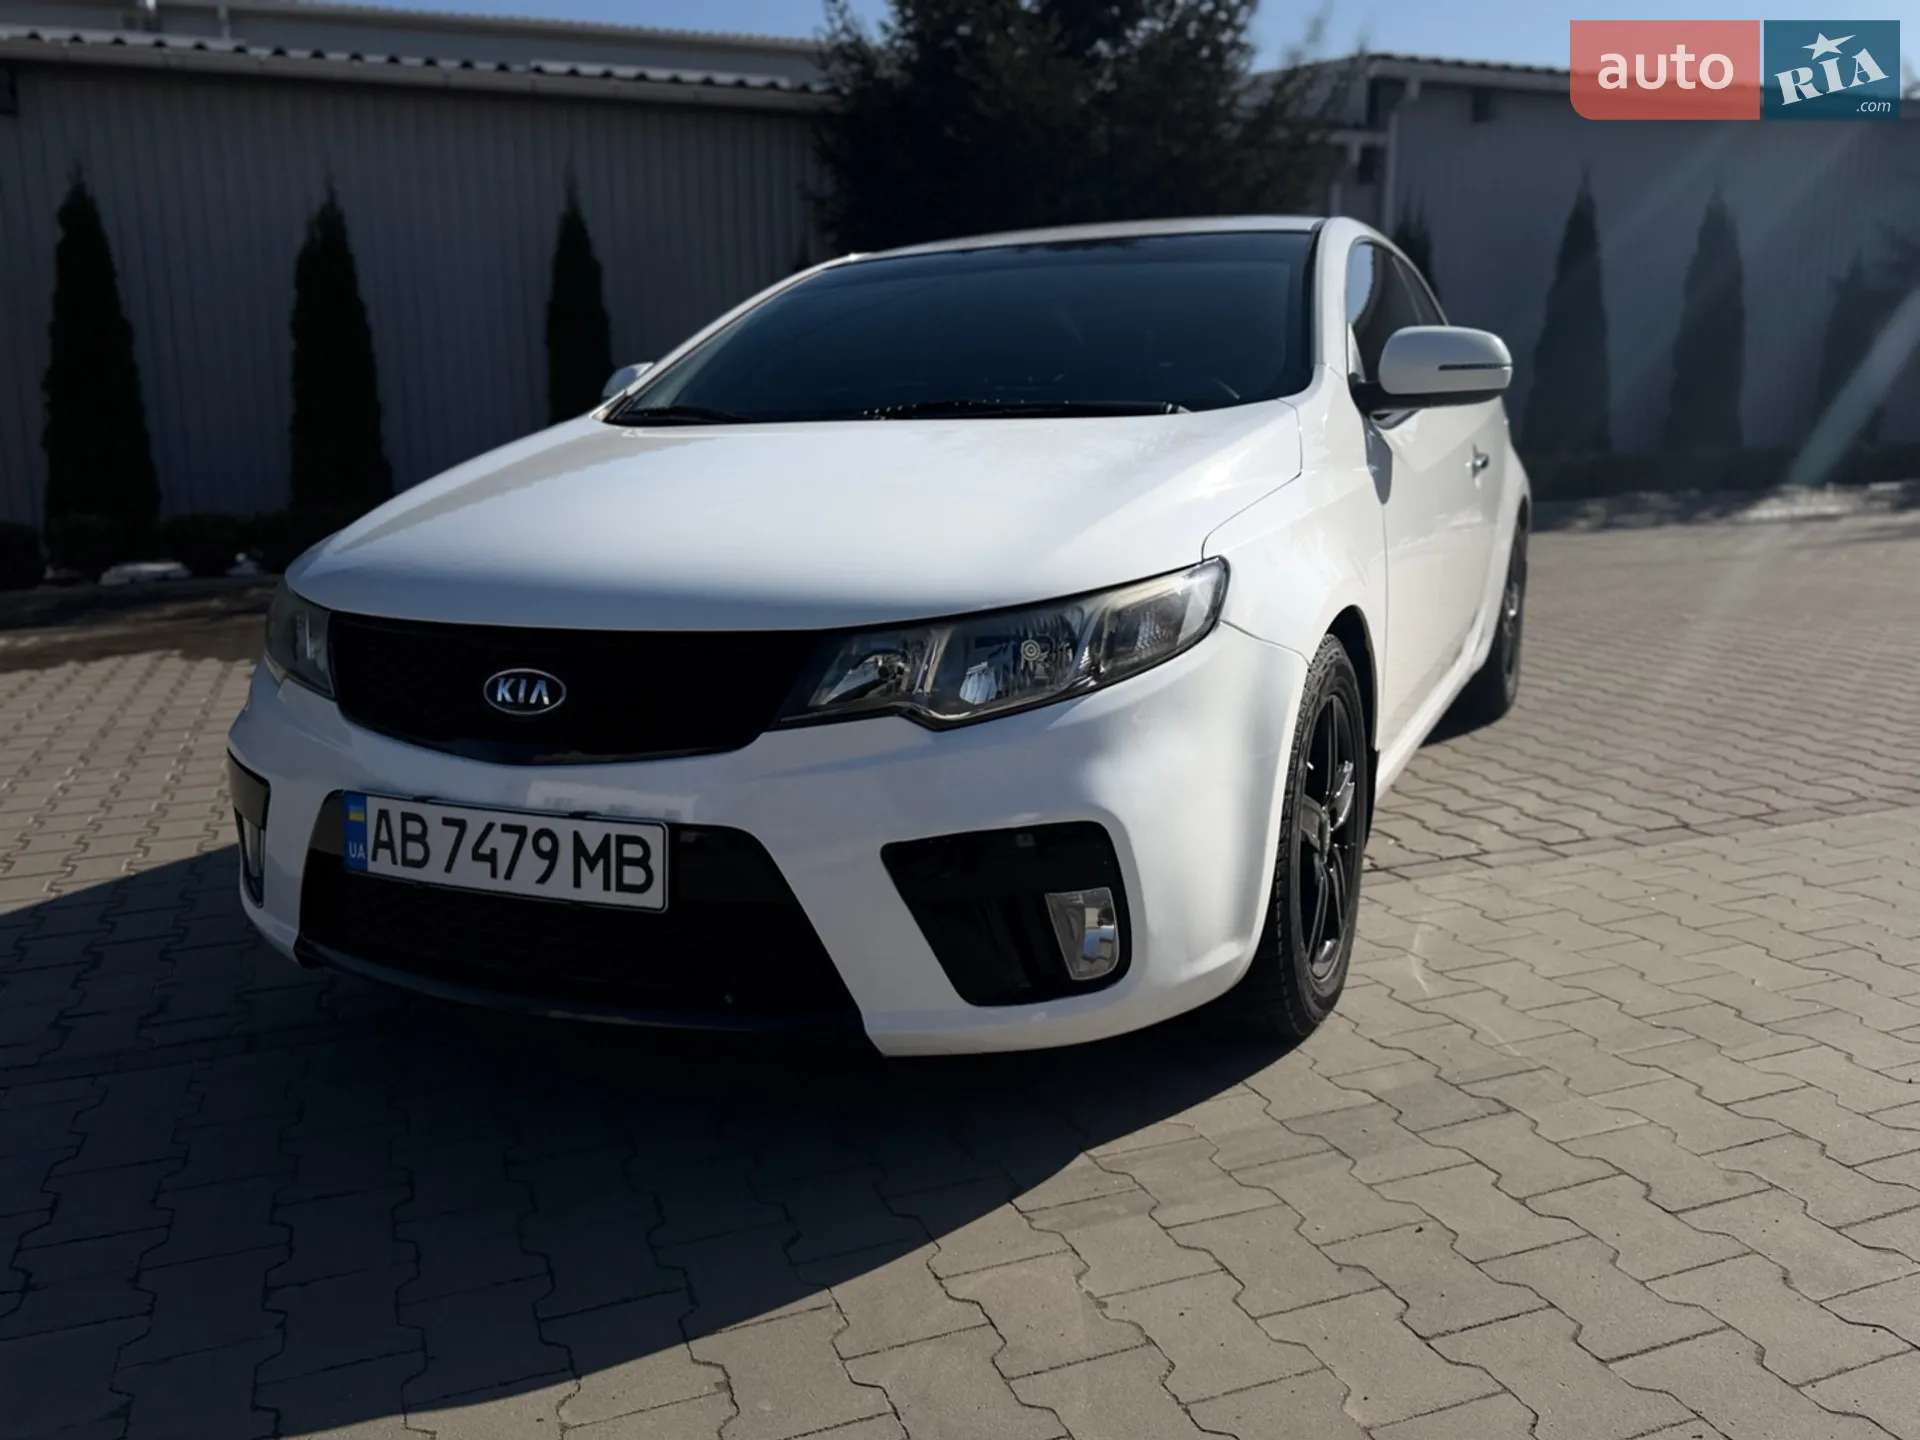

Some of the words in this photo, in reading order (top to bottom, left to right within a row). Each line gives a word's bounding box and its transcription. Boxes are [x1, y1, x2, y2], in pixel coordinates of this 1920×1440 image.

[496, 677, 550, 705] KIA
[349, 841, 367, 861] UA
[371, 808, 431, 869] AB
[441, 816, 560, 885] 7479
[572, 830, 655, 894] MB
